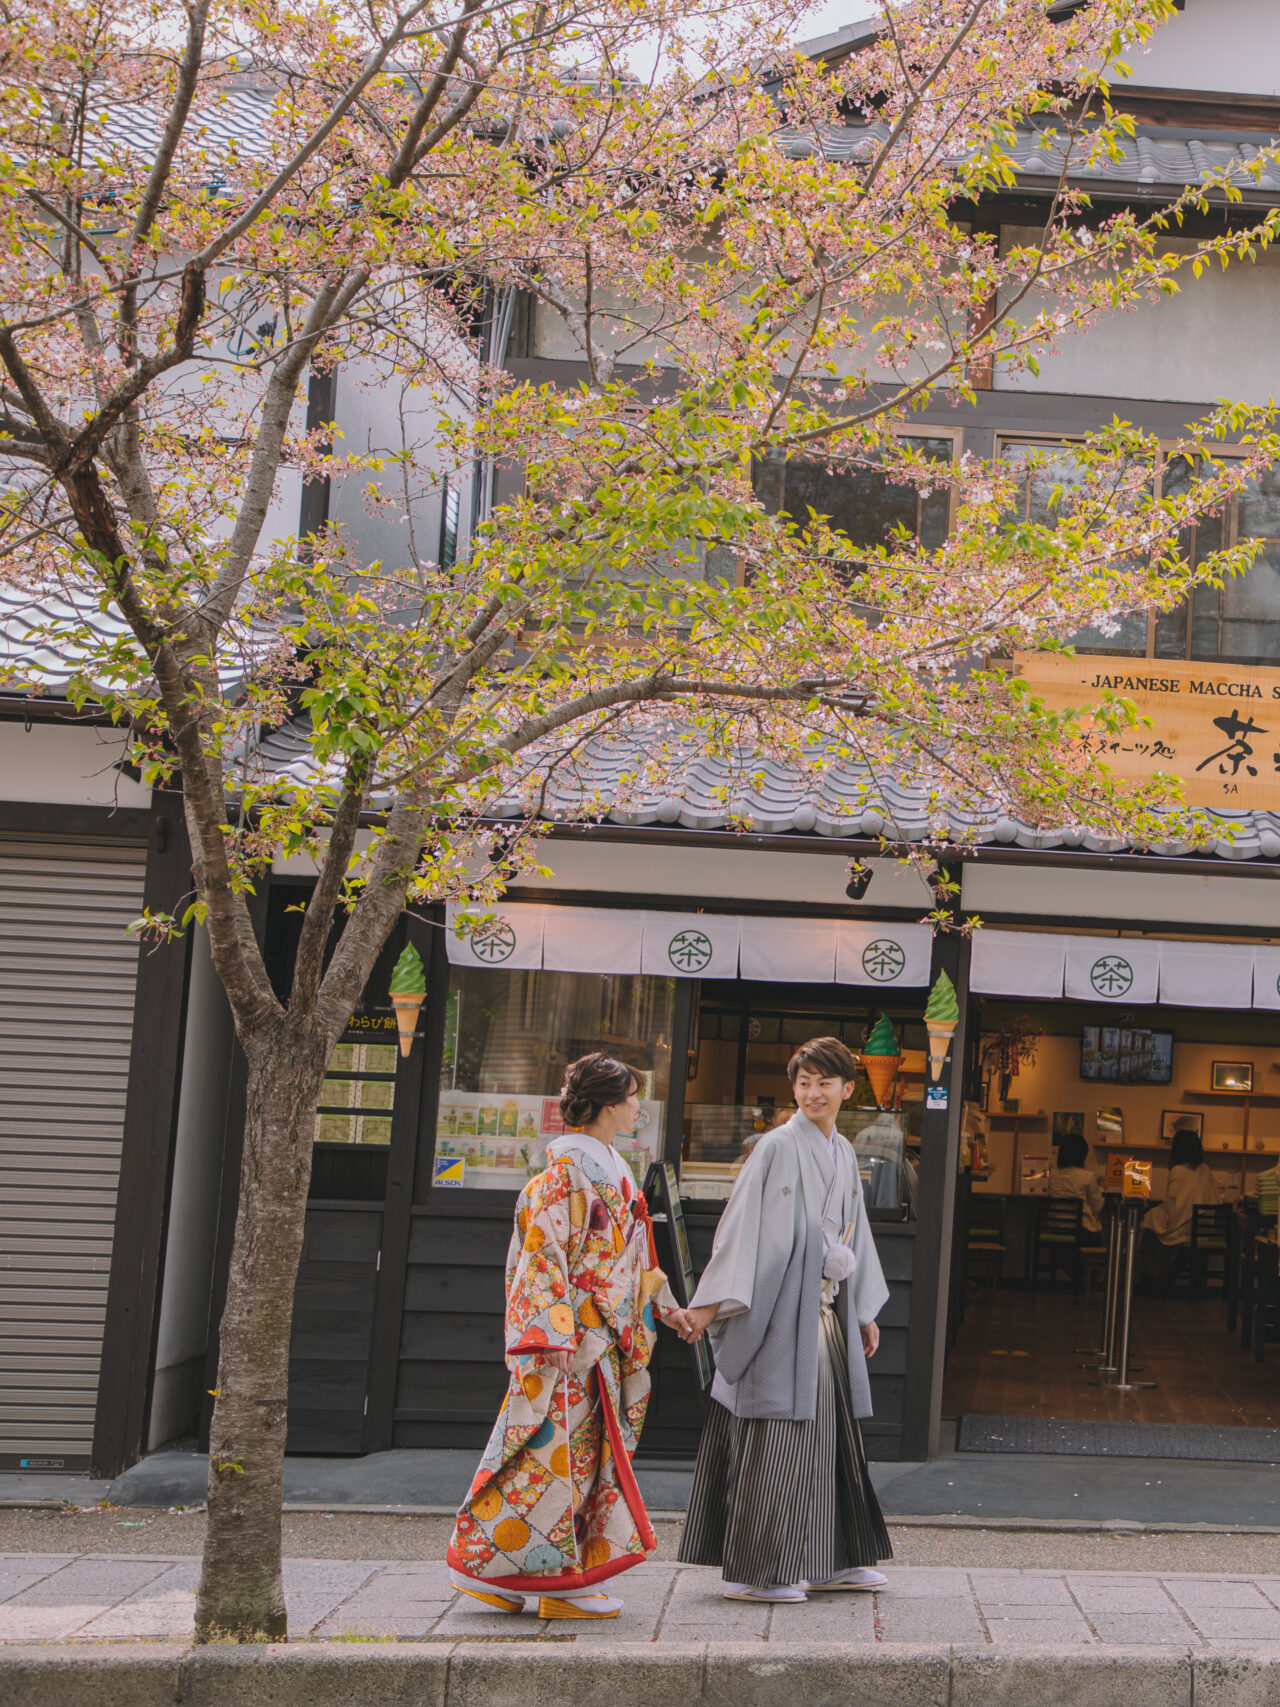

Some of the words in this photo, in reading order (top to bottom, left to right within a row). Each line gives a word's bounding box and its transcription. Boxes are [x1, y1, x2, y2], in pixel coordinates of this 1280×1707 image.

[1091, 674, 1180, 694] JAPANESE
[1189, 680, 1263, 698] MACCHA
[1223, 783, 1239, 795] SA
[668, 929, 713, 973] 茶
[862, 938, 905, 982] 茶
[1090, 955, 1133, 998] 茶
